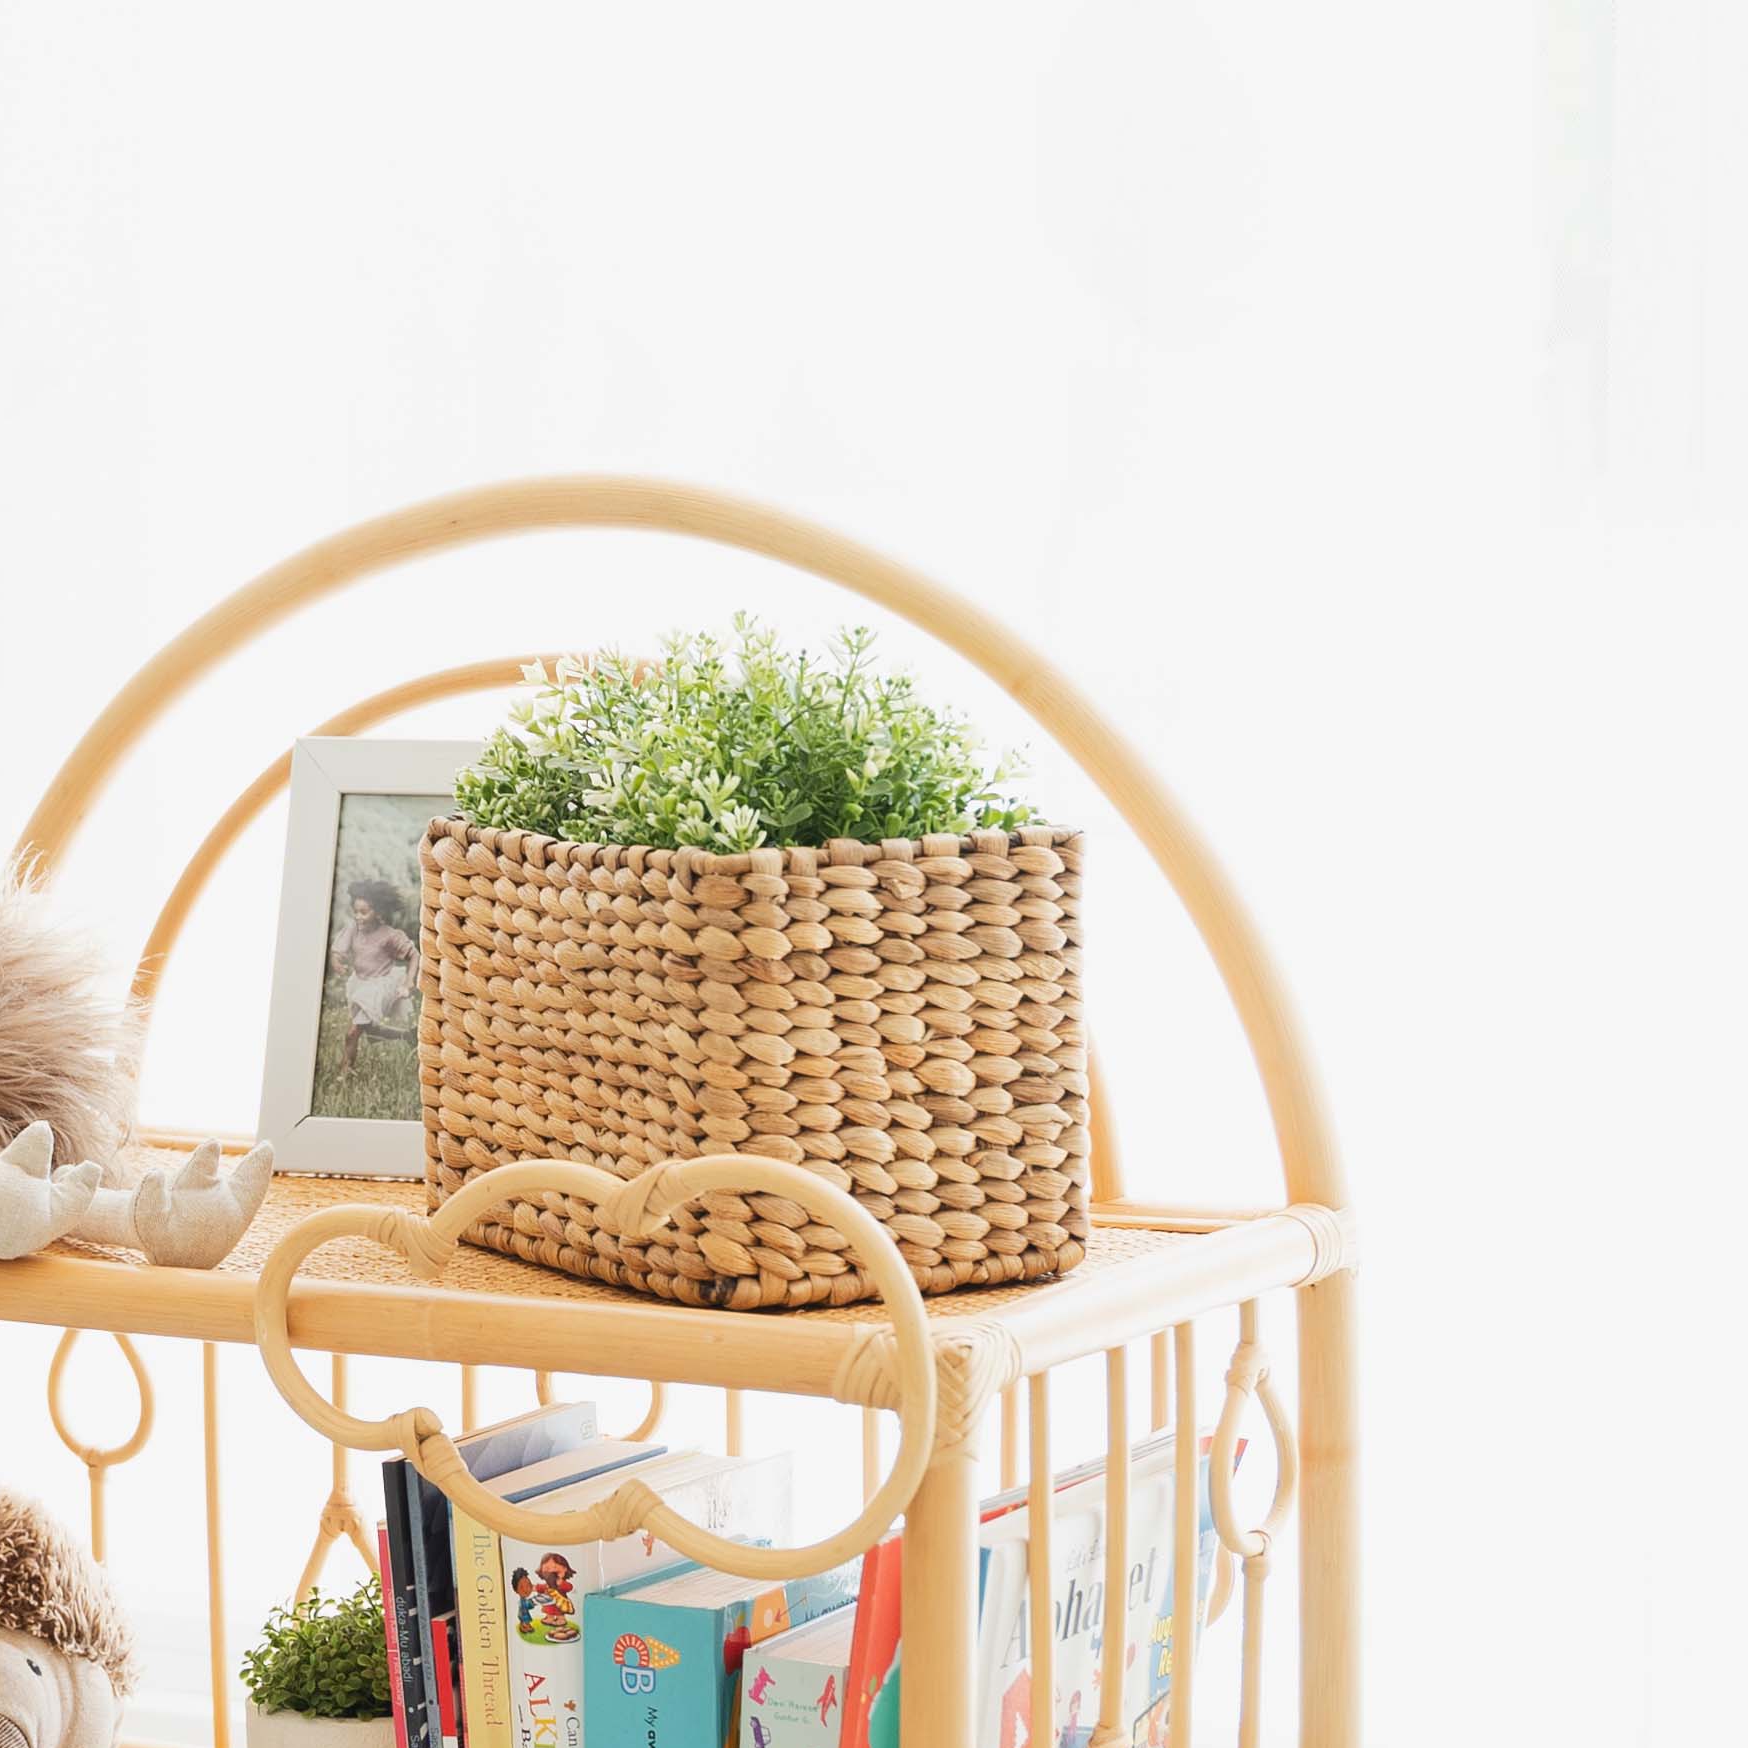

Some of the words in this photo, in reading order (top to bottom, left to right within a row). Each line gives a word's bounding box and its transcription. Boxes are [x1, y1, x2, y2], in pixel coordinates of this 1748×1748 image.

[473, 1529, 492, 1568] The
[396, 1596, 410, 1648] duka-Mu
[475, 1573, 496, 1649] Golden
[401, 1650, 413, 1684] abadi
[481, 1655, 504, 1726] Thread
[644, 1705, 659, 1730] My
